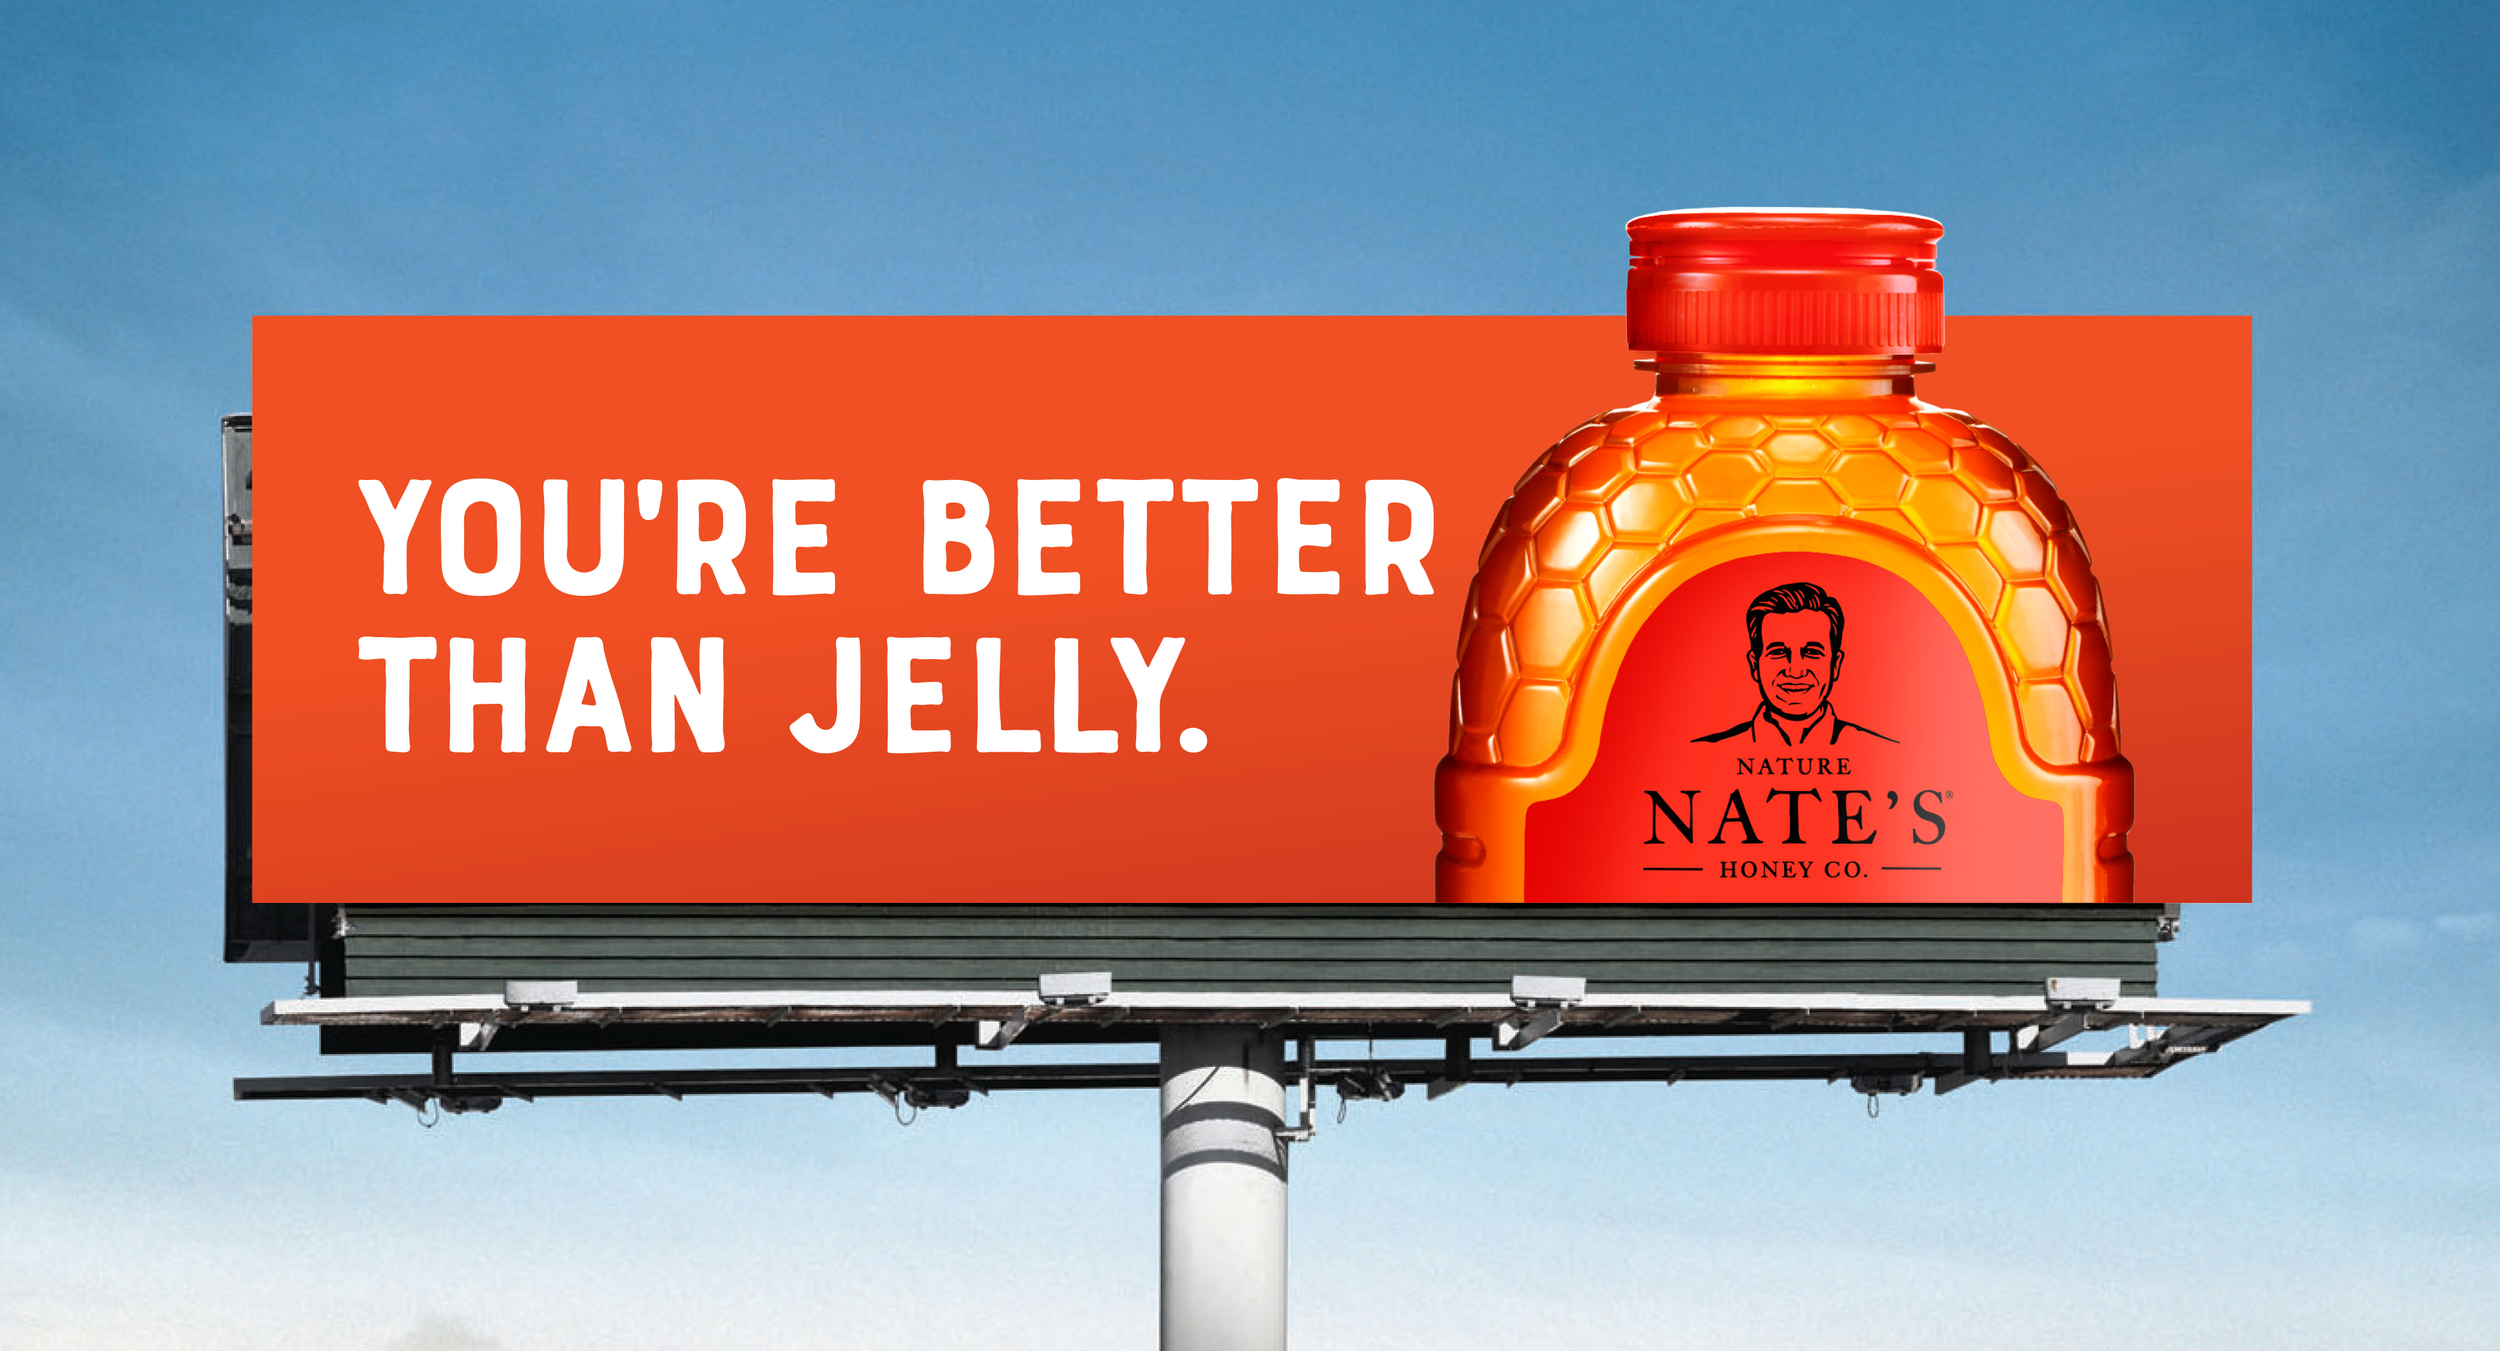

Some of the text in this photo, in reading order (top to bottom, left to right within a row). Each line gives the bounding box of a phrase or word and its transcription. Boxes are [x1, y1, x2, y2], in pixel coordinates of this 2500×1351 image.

[358, 477, 1438, 597] YOU'RE BETTER
[358, 636, 1208, 754] THAN JELLY.
[1736, 757, 1852, 776] NATURE
[1720, 860, 1869, 879] HONEY CO.
